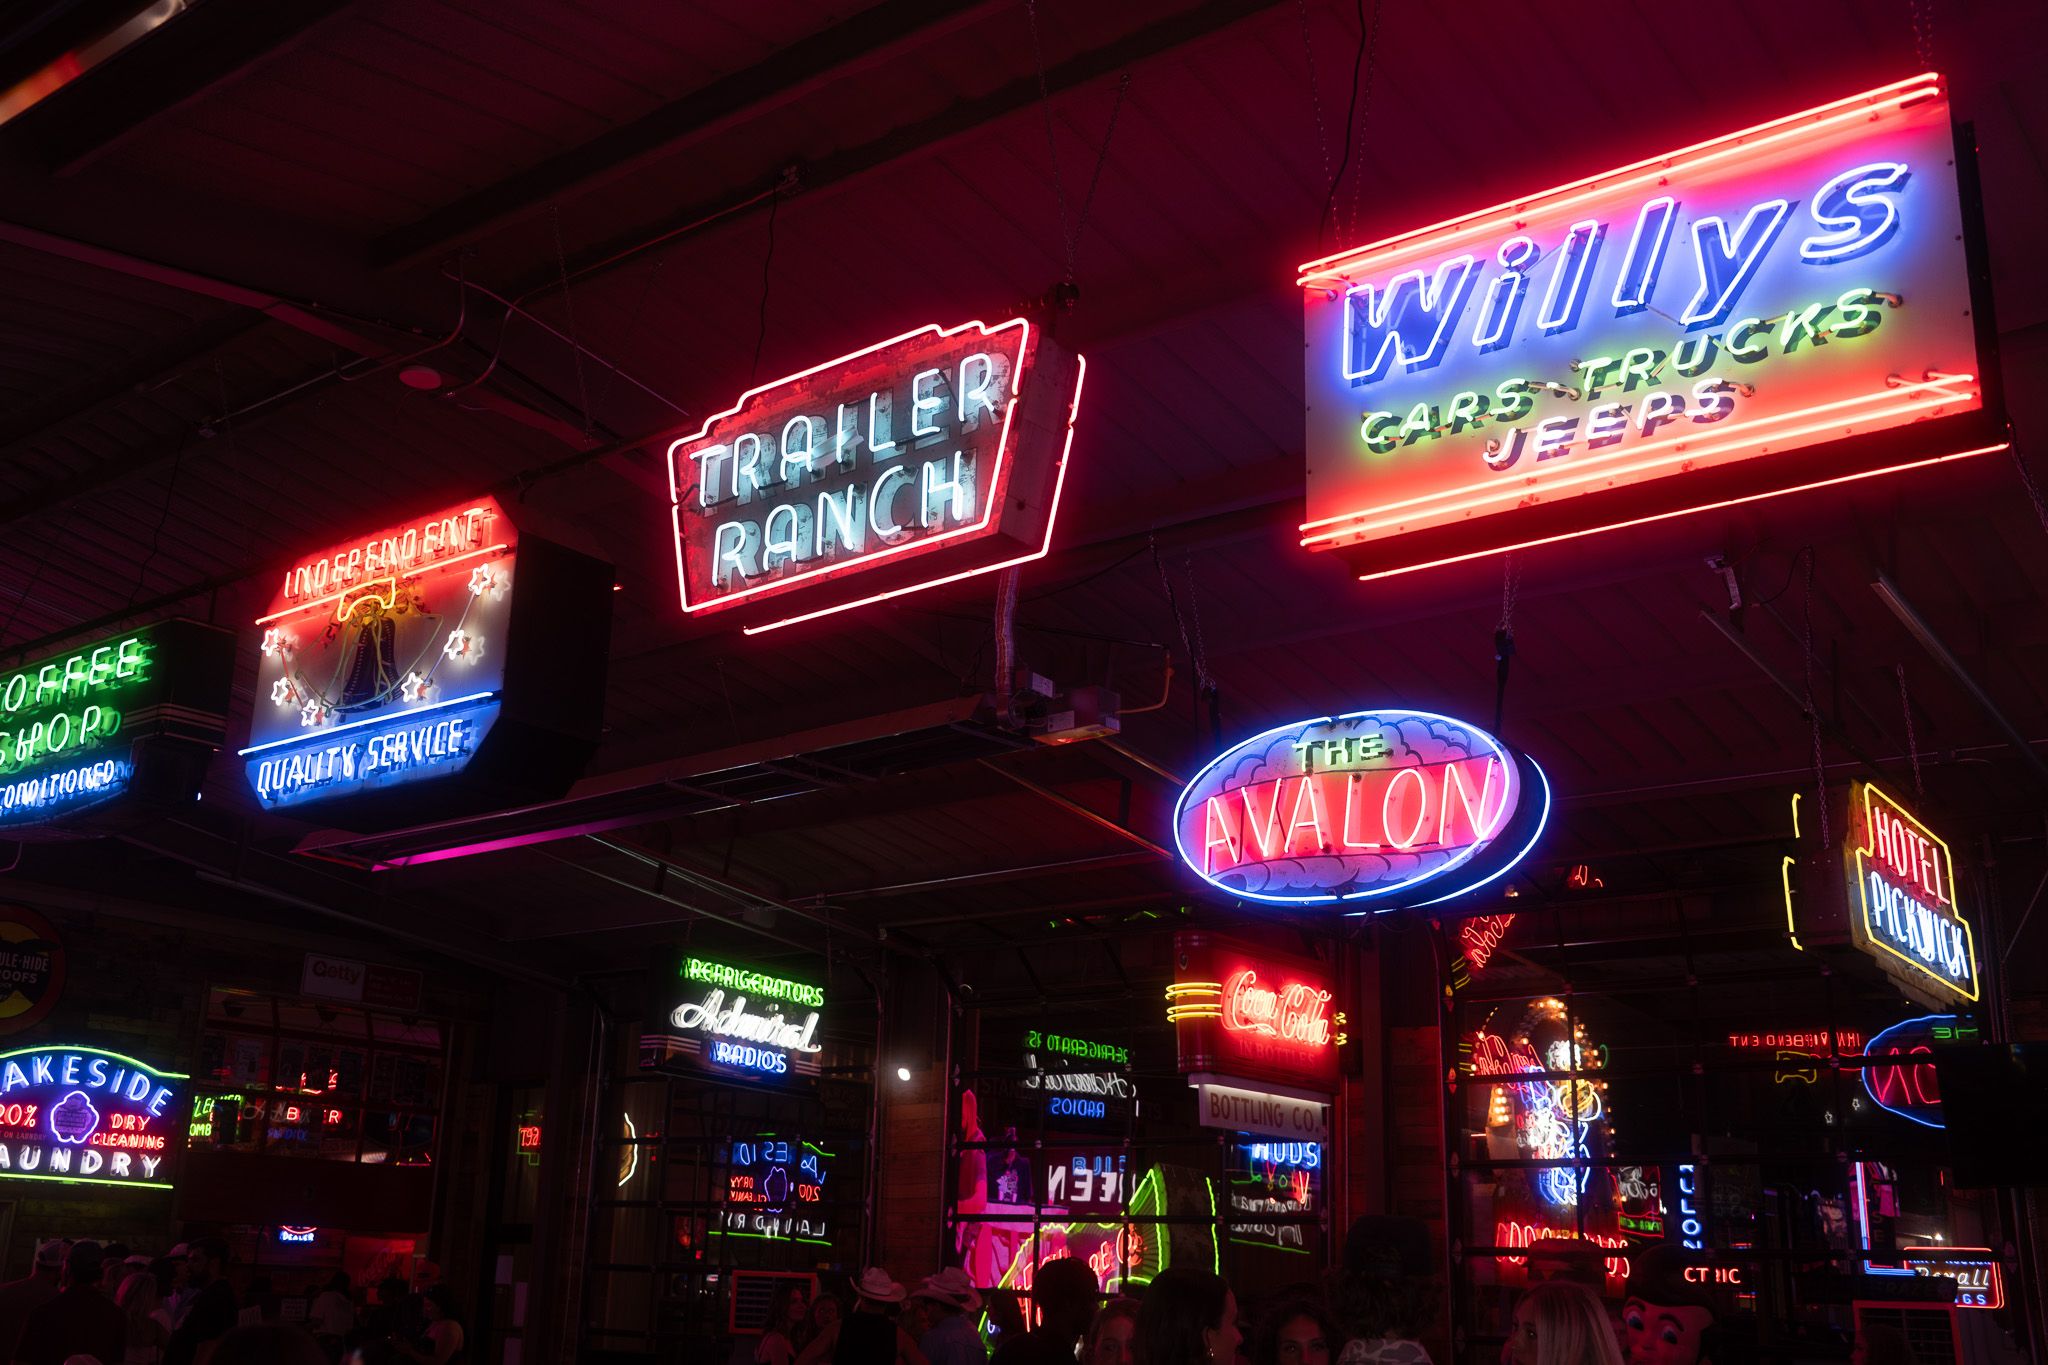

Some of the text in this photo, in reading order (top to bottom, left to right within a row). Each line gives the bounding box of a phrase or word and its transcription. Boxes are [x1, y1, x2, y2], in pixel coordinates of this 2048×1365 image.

[1341, 162, 1910, 388] Willys
[689, 352, 1009, 518] TRAILER
[1483, 377, 1736, 471] JEEPS
[284, 507, 492, 598] INDEPENDENT
[711, 446, 979, 594] RANCH
[0, 638, 140, 713] OFFEE
[256, 720, 464, 798] QUALITY SERVICE
[1292, 733, 1390, 774] THE
[1203, 757, 1497, 876] AVALON
[1874, 806, 1951, 904] HOTEL
[1871, 870, 1970, 979] PICKWICK
[0, 968, 38, 984] OOFS
[684, 957, 824, 1008] REFRIGERATORS
[671, 986, 822, 1053] Admiral
[0, 1055, 173, 1117] AKESIDE
[712, 1042, 787, 1074] RADIOS
[90, 1132, 165, 1149] CLEANING
[111, 1113, 150, 1131] DRY
[1210, 1093, 1320, 1133] BOTTLING CO.
